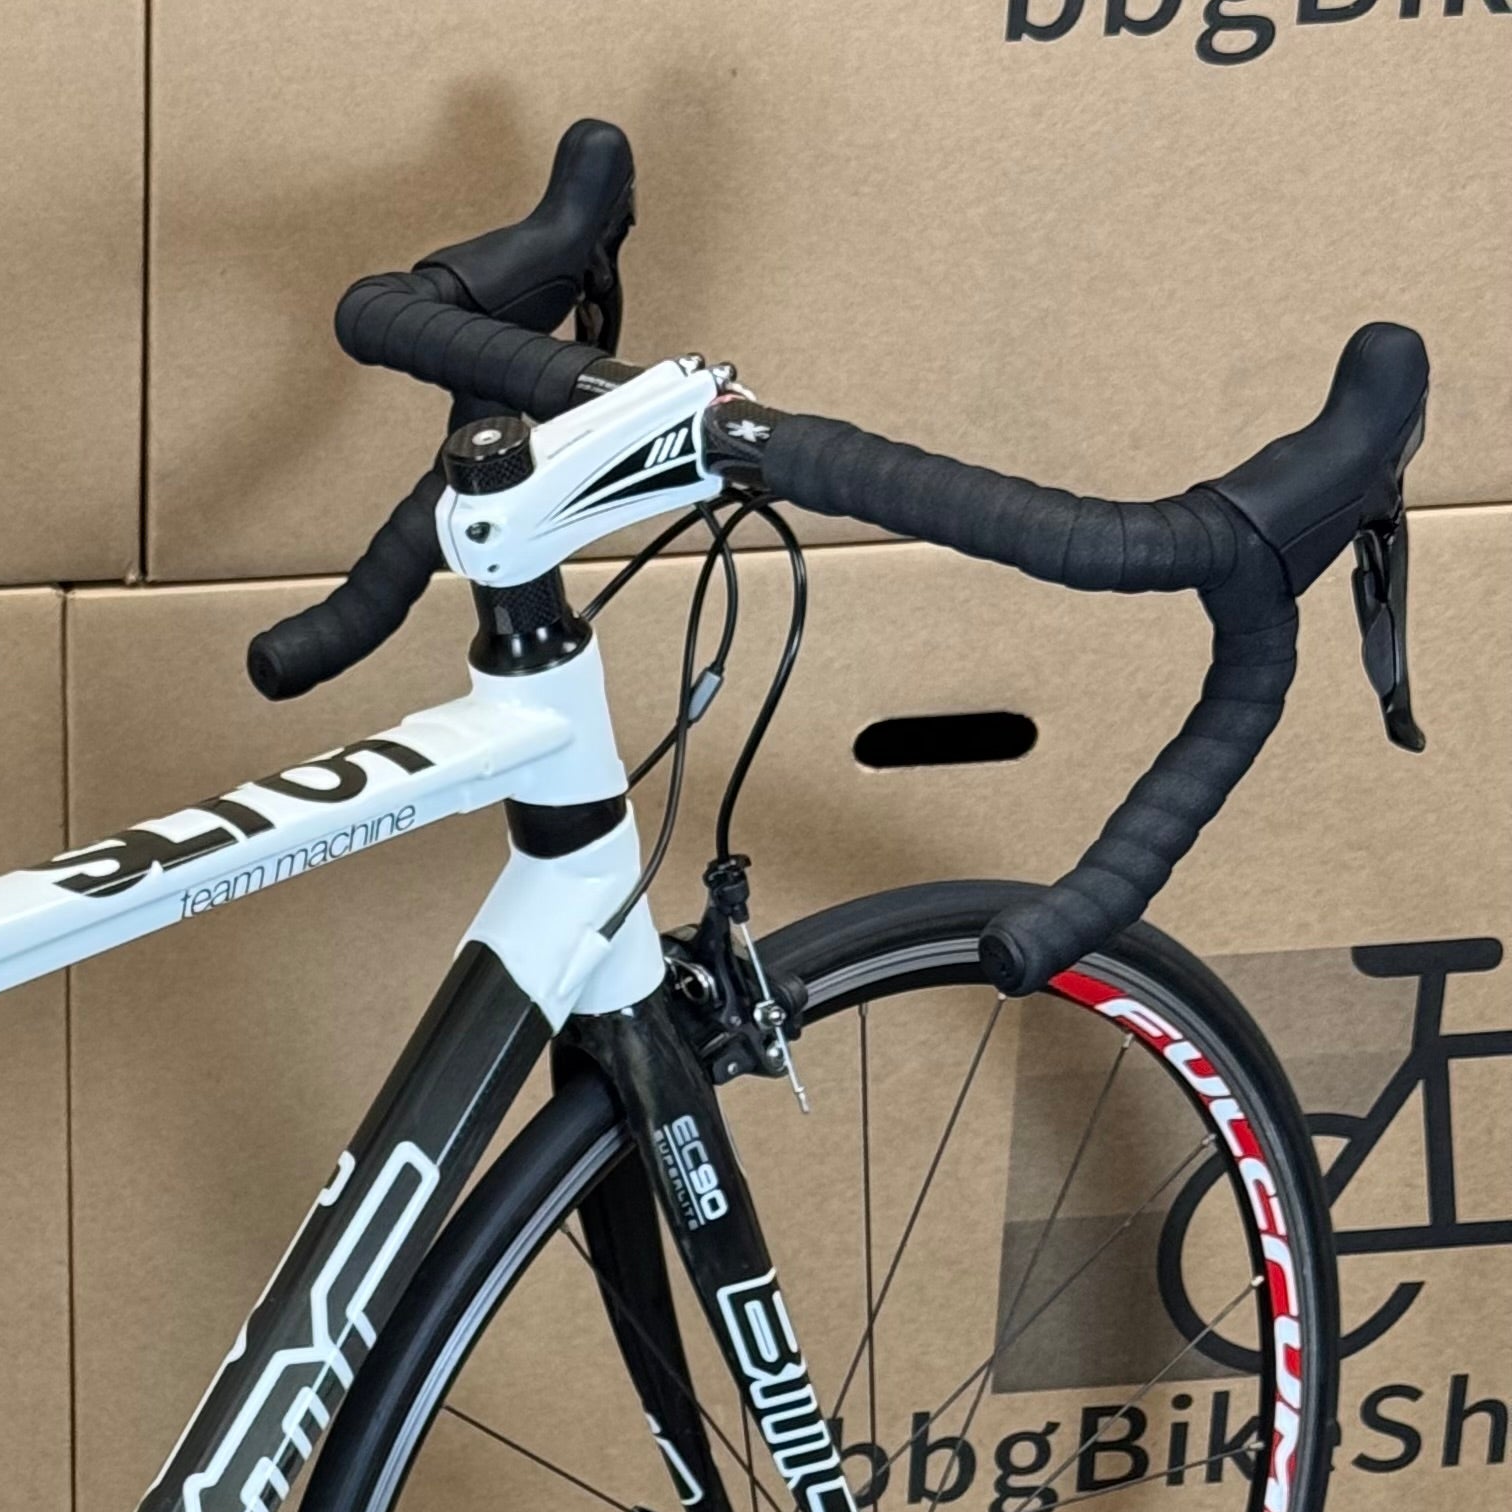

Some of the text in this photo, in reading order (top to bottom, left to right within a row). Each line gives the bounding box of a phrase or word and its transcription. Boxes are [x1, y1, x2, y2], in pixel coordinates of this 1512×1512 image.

[181, 804, 417, 920] team machine
[653, 1128, 700, 1231] SUPERLITE
[672, 1113, 728, 1223] EC90
